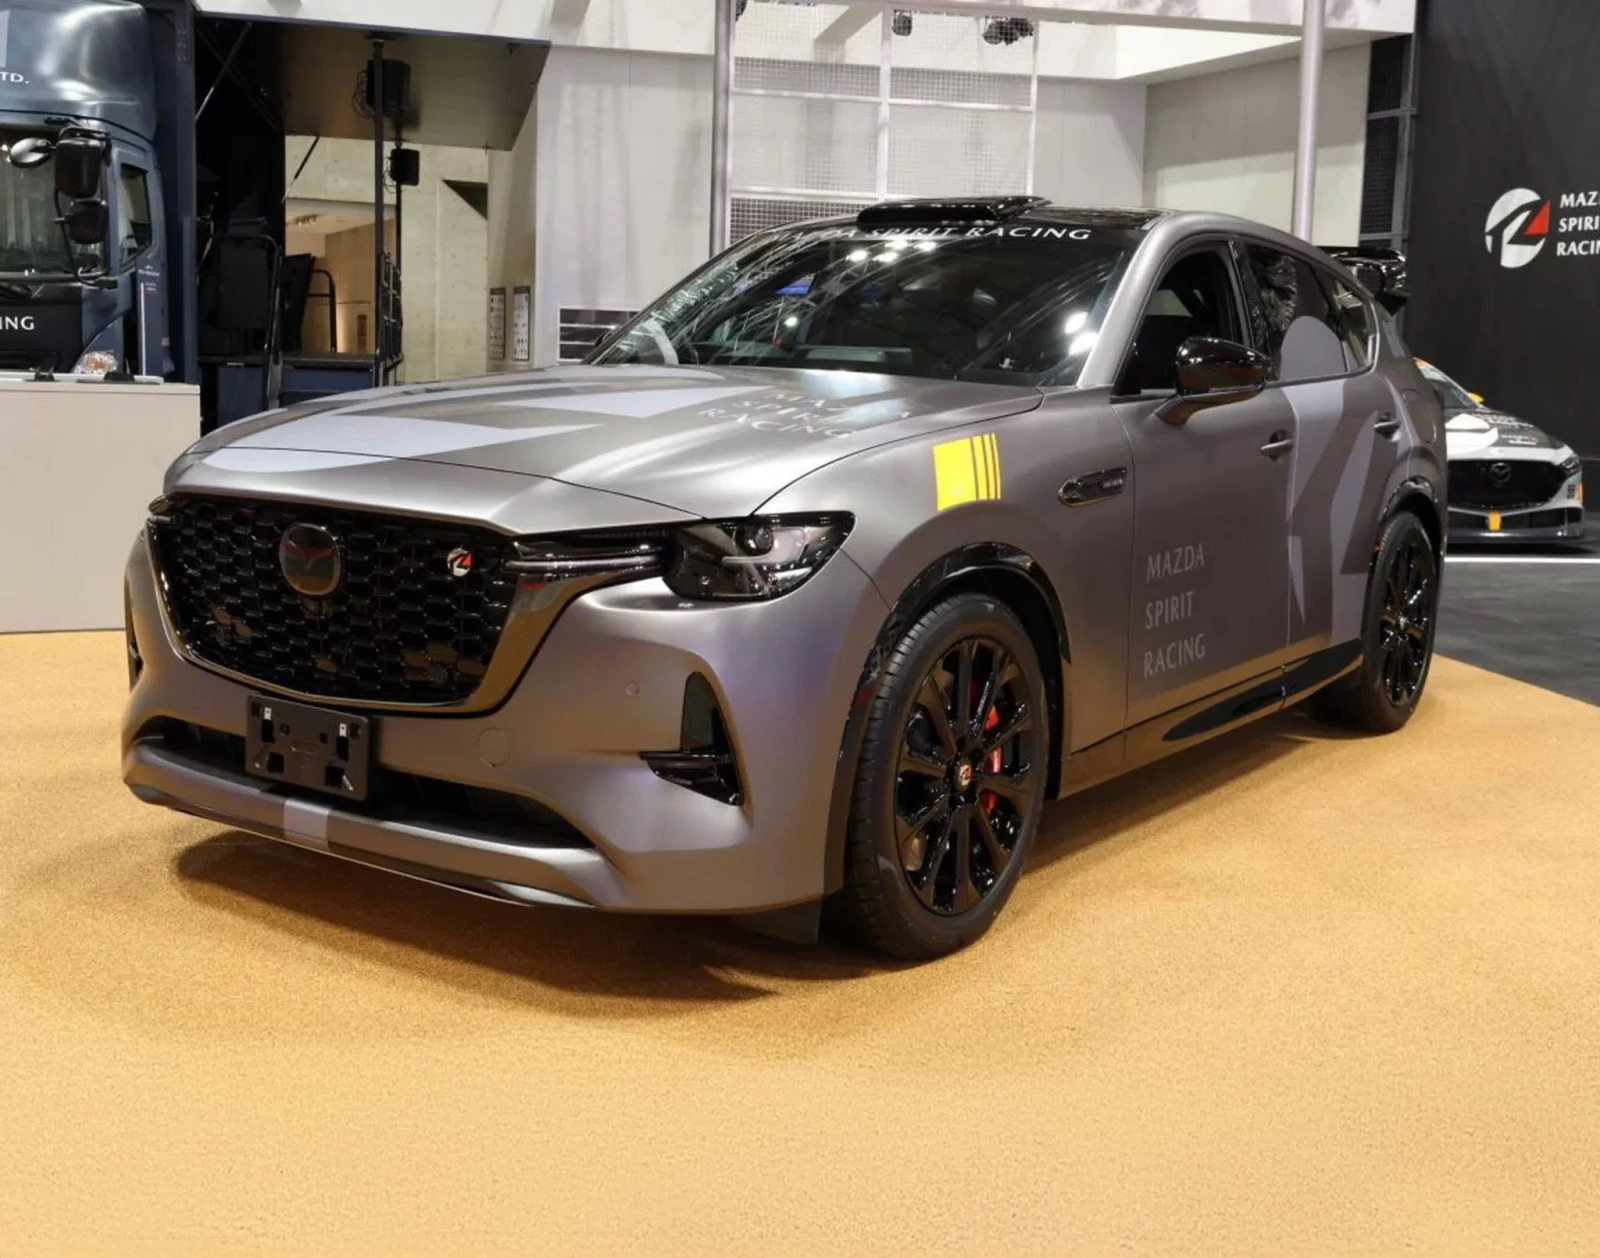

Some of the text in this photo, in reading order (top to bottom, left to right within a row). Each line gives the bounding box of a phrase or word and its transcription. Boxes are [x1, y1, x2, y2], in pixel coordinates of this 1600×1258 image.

[1560, 190, 1600, 209] MAZ
[965, 227, 1092, 240] RACING
[1558, 215, 1600, 233] SPIRI
[1146, 543, 1206, 582] MAZDA
[1145, 590, 1194, 630] SPIRIT
[1144, 632, 1206, 679] RACING
